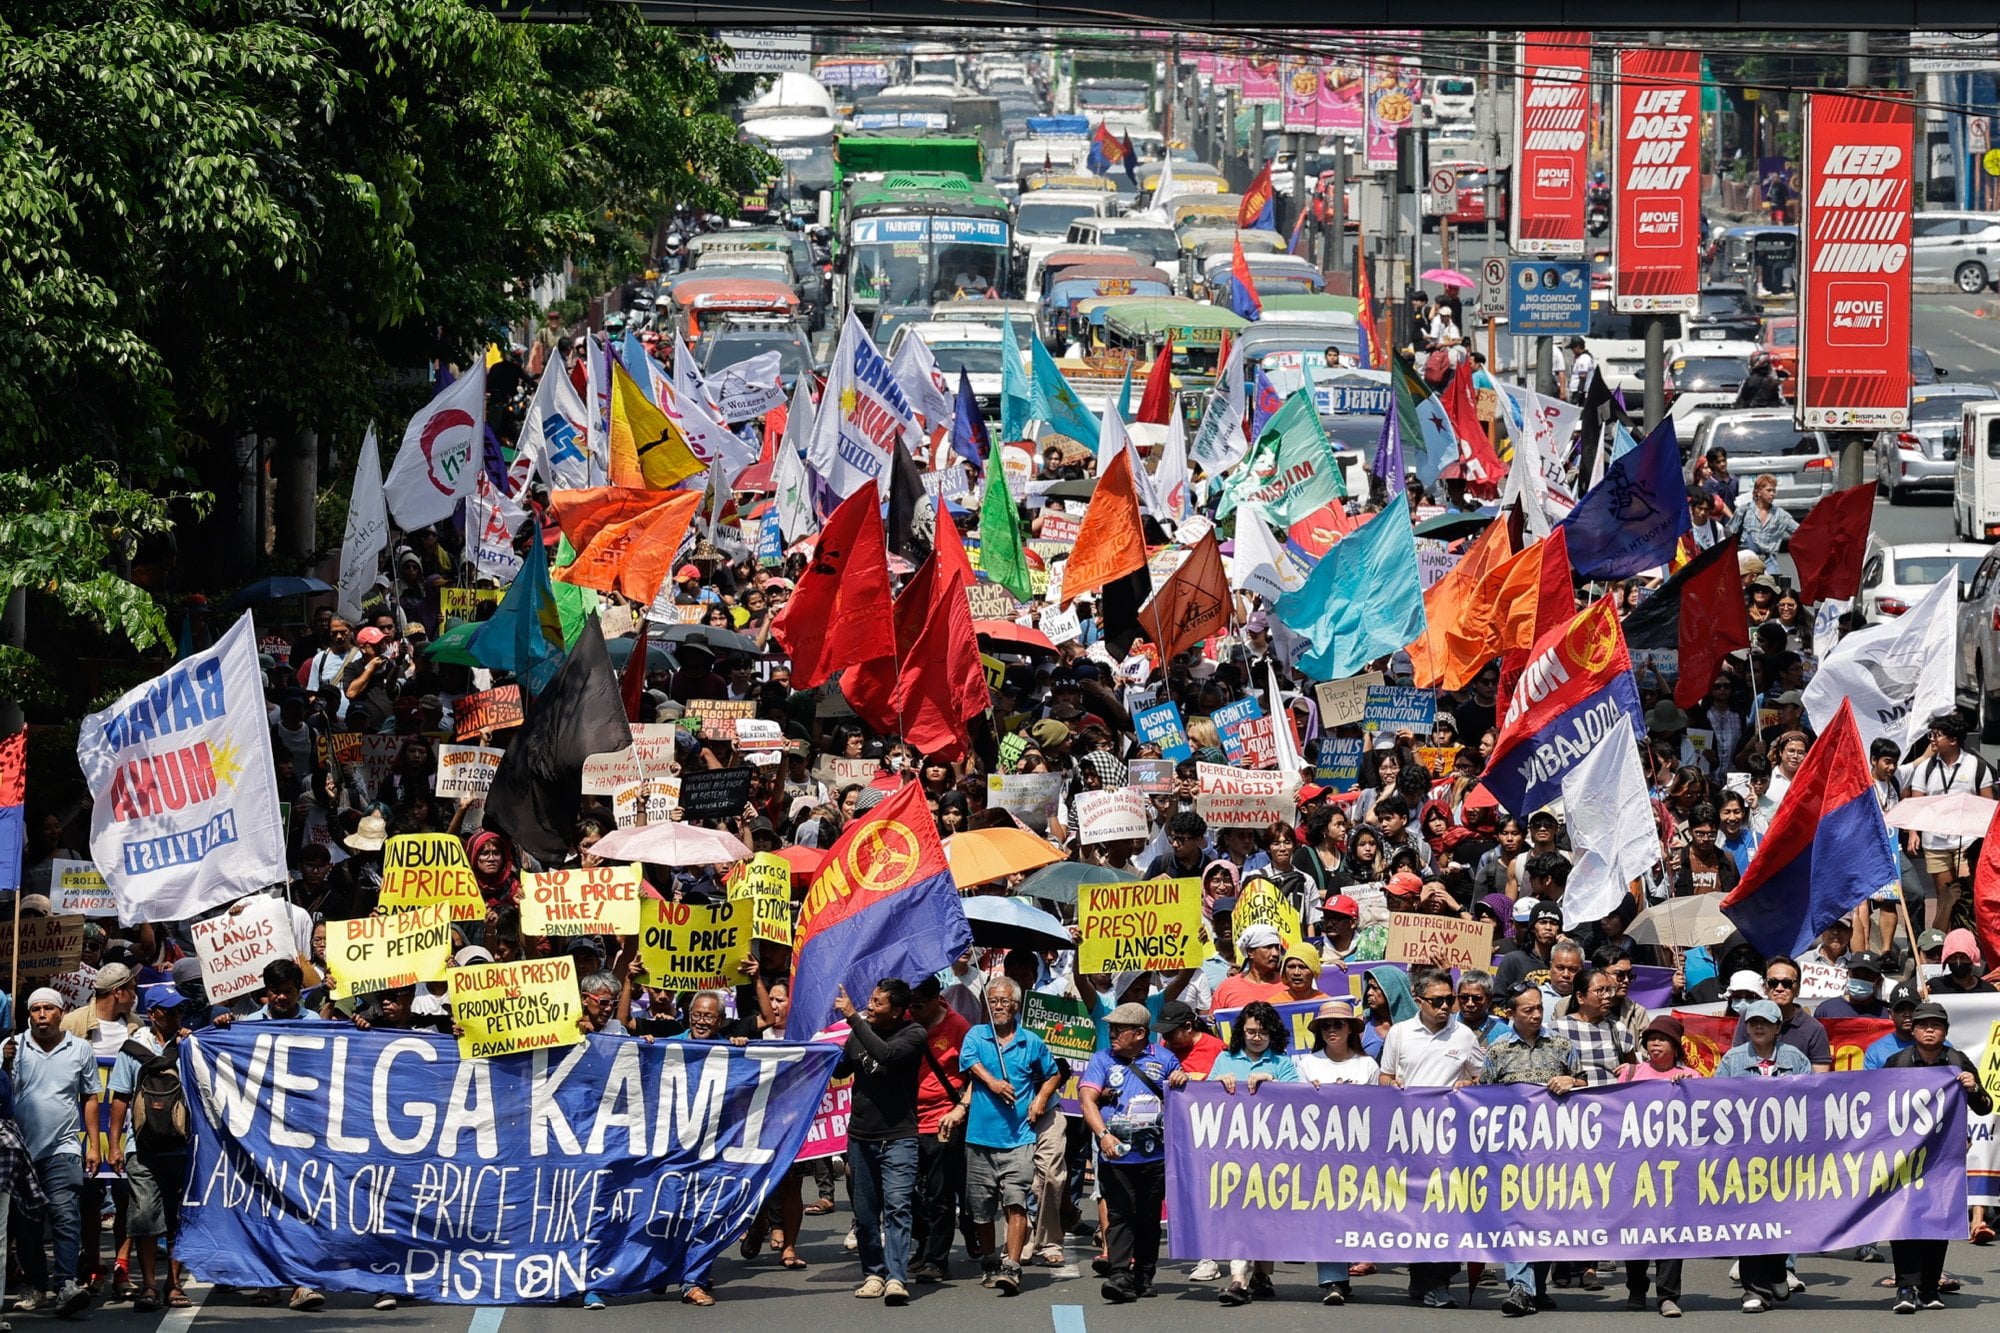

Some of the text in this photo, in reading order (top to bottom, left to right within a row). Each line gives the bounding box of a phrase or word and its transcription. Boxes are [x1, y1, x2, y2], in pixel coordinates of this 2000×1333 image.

[1633, 90, 1687, 114] LIFE
[1626, 115, 1693, 140] DOES
[1632, 141, 1686, 165] NOT
[1822, 144, 1902, 176] KEEP
[1537, 167, 1570, 178] MOVE
[1626, 166, 1692, 191] WAIT
[1638, 211, 1679, 223] MOVE
[857, 222, 876, 241] 7
[1484, 304, 1505, 312] TURN
[1519, 303, 1582, 311] APPREHENSION
[1540, 294, 1577, 303] CONTACT
[1833, 300, 1884, 314] MOVE
[1530, 312, 1571, 320] IN EFFECT
[1365, 705, 1428, 721] CORRUPTION!
[1393, 696, 1416, 709] VAT
[1239, 723, 1257, 740] OIL
[1321, 739, 1362, 754] BUWIS
[837, 763, 856, 778] OIL
[1333, 756, 1358, 767] LANGIS
[1138, 771, 1161, 782] TAX
[1255, 798, 1267, 807] SA
[1205, 809, 1281, 823] MAMAMYAN
[401, 869, 480, 898] PRICES
[535, 867, 614, 887] NO TO
[535, 883, 636, 903] OIL PRICE
[1088, 883, 1180, 911] KONTROLIN
[347, 904, 446, 941] BUY-BACK
[546, 901, 605, 922] HIKE!
[660, 901, 733, 926] NO TO
[191, 916, 236, 940] TAX SA
[211, 918, 274, 953] LANGIS
[1085, 910, 1183, 939] PRESYO ng
[1392, 913, 1483, 937] OIL DEREGULATION
[346, 924, 450, 962] OF PETRON!
[645, 927, 738, 952] OIL PRICE
[1115, 934, 1190, 958] LANGIS!
[1420, 930, 1457, 945] LAW
[209, 938, 278, 975] IBASURA
[671, 953, 727, 975] HIKE!
[1102, 956, 1186, 972] BAYAN MUNA
[454, 961, 570, 994] ROLLBACK PRESYO
[505, 986, 521, 998] NG
[458, 997, 549, 1020] PRODUKTONG
[1028, 997, 1045, 1010] OIL
[487, 1003, 570, 1034] PETROLYO!
[1025, 1019, 1047, 1033] LAW
[1044, 1026, 1096, 1051] Ibasura!
[190, 1032, 806, 1165] WELGA KAMI
[1189, 1085, 1947, 1155] WAKASAN ANG GERANG AGRESYON NG US!
[183, 1132, 287, 1223] LABAN
[296, 1159, 341, 1226] SA
[349, 1163, 398, 1237] OIL
[532, 1164, 613, 1245] HIKE
[611, 1187, 644, 1219] AT
[1209, 1145, 1927, 1215] IPAGLABAN ANG BUHAY AT KABUHAYAN!
[1456, 1227, 1610, 1249] ALYANSANG
